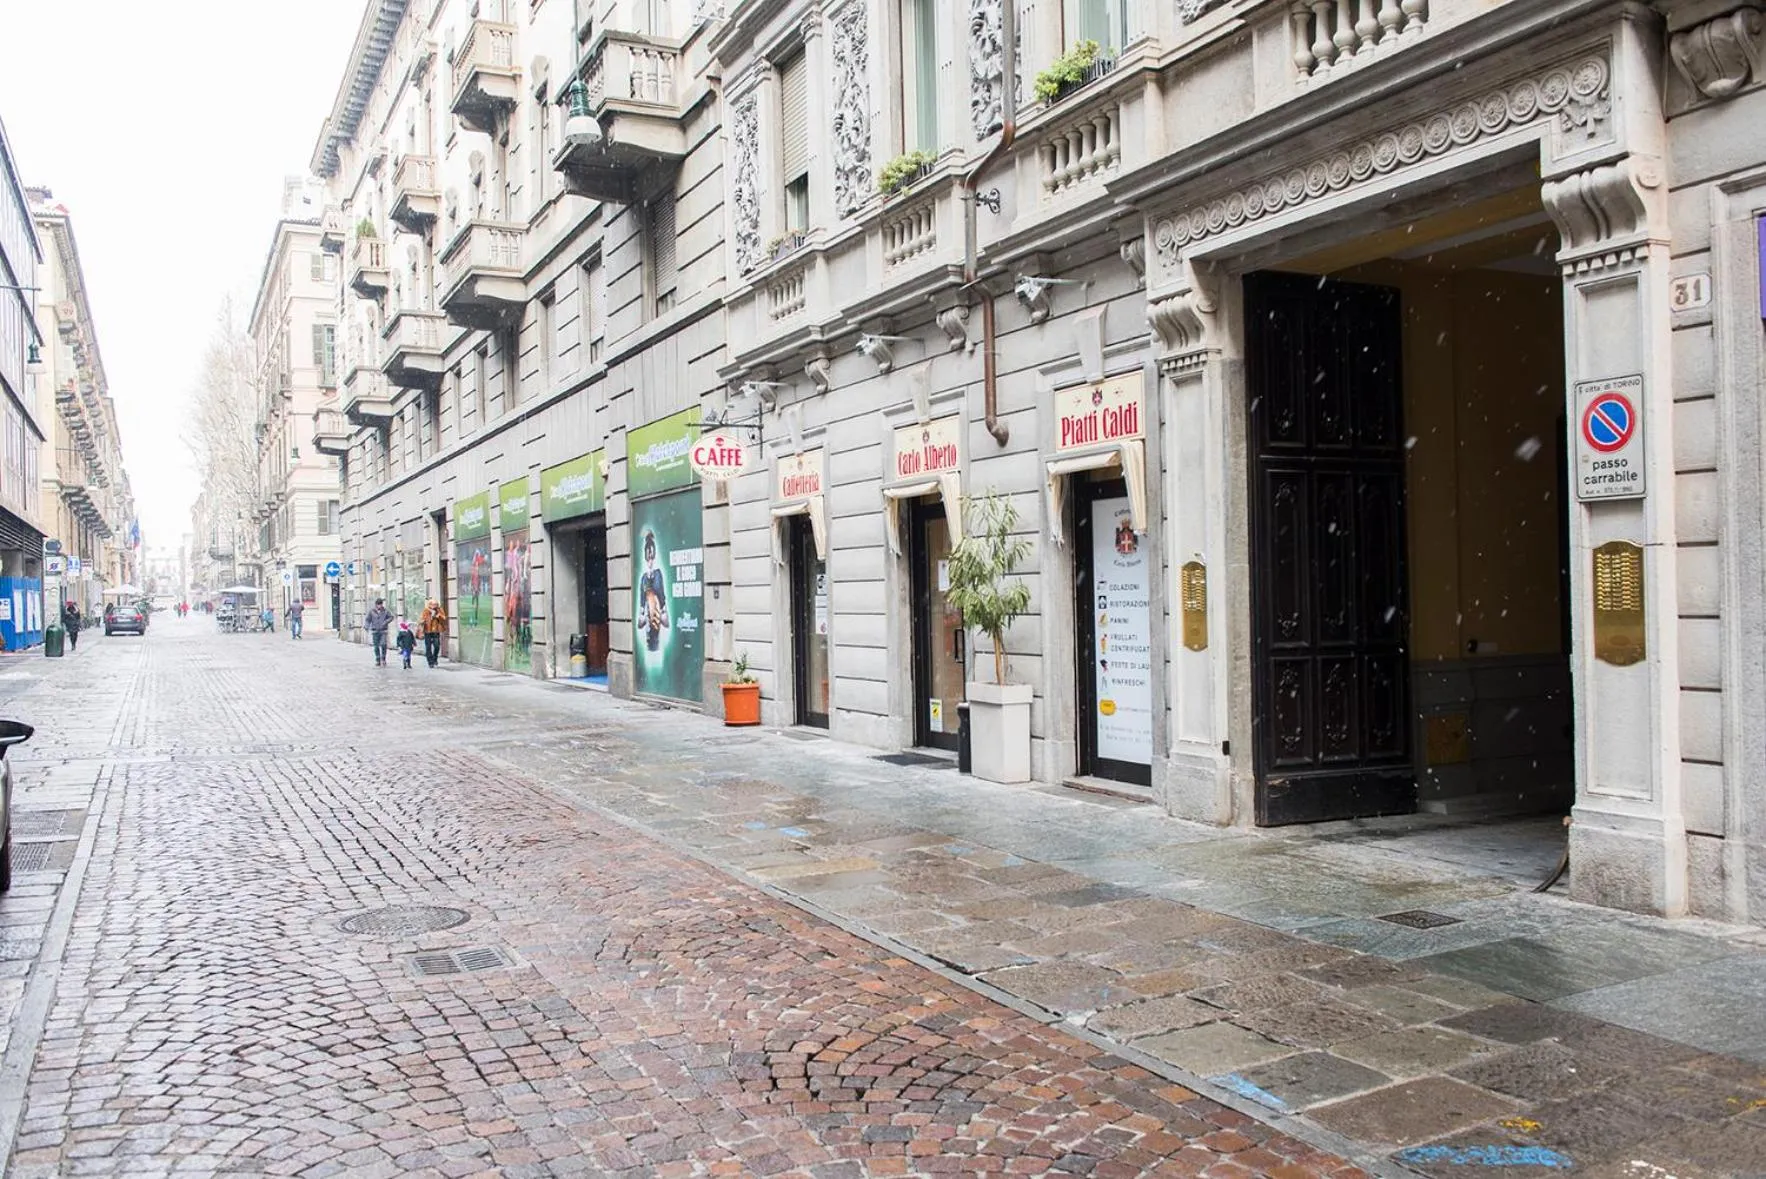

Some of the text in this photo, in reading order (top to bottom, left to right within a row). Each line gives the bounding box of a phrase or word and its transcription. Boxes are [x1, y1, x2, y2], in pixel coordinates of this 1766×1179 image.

[1675, 278, 1702, 305] 31
[1612, 379, 1641, 389] TORINO
[1061, 401, 1138, 446] Piatti Caldi
[898, 443, 957, 475] Carlo Alberto
[1592, 458, 1628, 471] passo
[1584, 470, 1638, 485] carrabile
[1109, 583, 1140, 591] COLAZIONI
